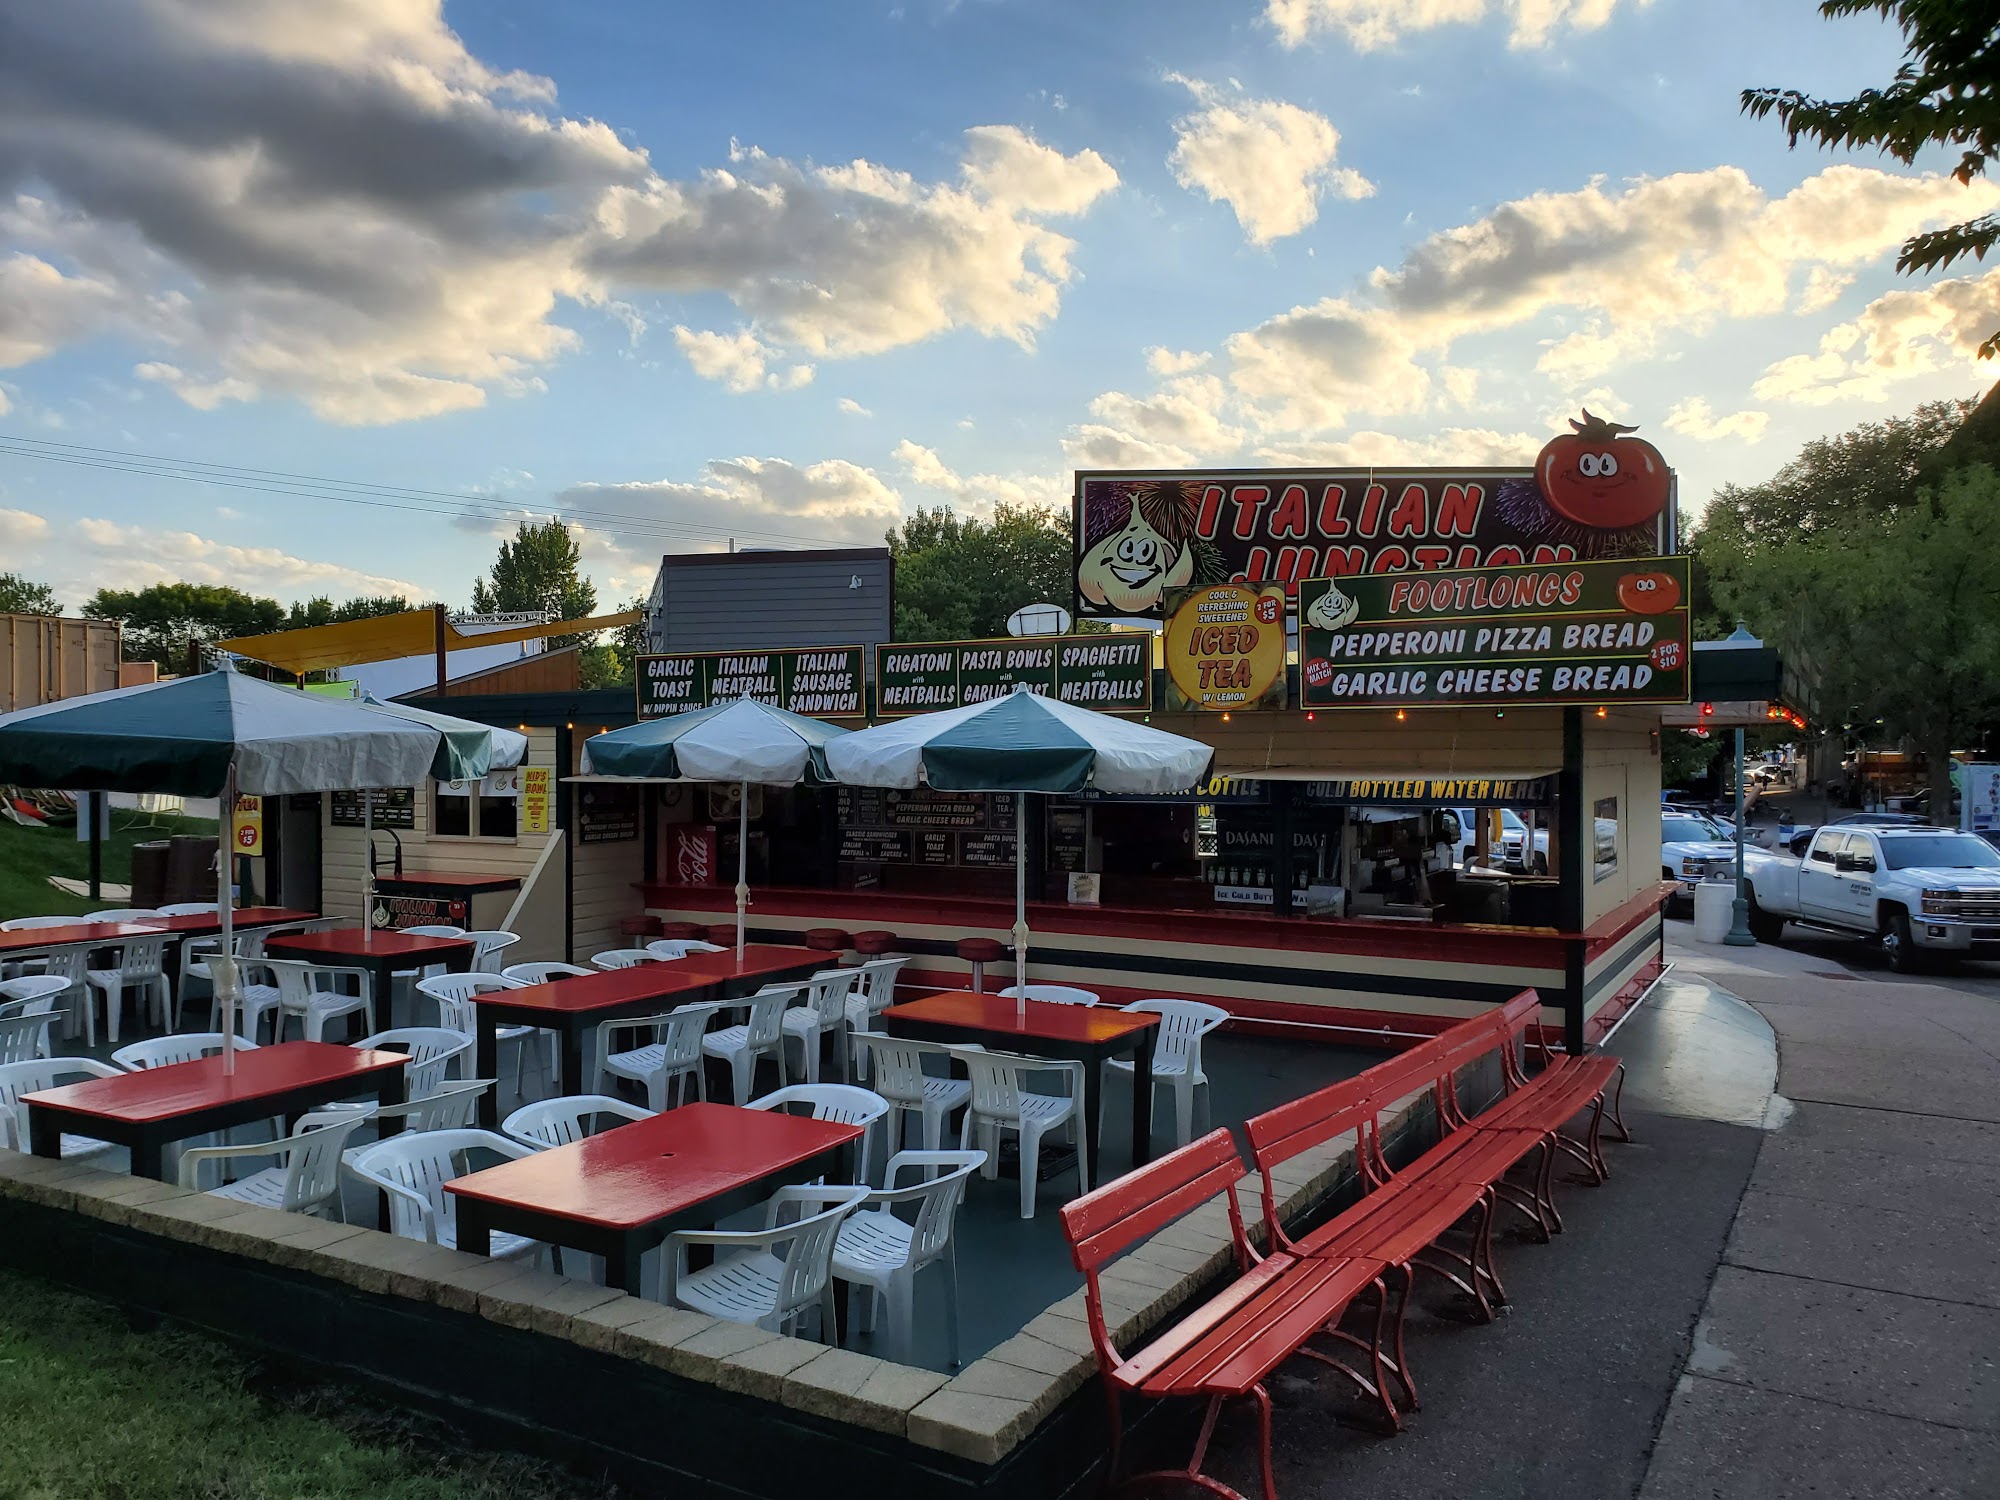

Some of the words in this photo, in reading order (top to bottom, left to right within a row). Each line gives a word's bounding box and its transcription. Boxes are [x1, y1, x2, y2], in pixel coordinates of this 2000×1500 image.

[1195, 483, 1485, 540] ITALIAN
[1209, 591, 1228, 600] COOL
[1231, 590, 1238, 599] &
[1389, 571, 1584, 614] FOOTLONGS
[1198, 601, 1249, 612] REFRESHING
[1263, 600, 1276, 609] FOR
[1199, 613, 1248, 623] SWEETENED
[1263, 608, 1276, 620] $5
[1189, 625, 1259, 656] ICED
[1330, 629, 1466, 658] PEPPERONI
[1475, 626, 1552, 652] PIZZA
[1563, 622, 1654, 649] BREAD
[1061, 645, 1142, 667] SPAGHETTI
[1651, 648, 1657, 659] 2
[1660, 643, 1680, 656] FOR
[717, 656, 769, 675] ITALIAN
[796, 652, 848, 672] ITALIAN
[886, 653, 952, 674] RIGATONI
[961, 651, 1002, 671] PASTA
[1006, 649, 1053, 669] BOWLS
[1660, 655, 1677, 669] $10
[647, 659, 694, 677] GARLIC
[1092, 670, 1105, 679] with
[1198, 659, 1252, 689] TEA
[1307, 662, 1320, 674] MIX
[1309, 668, 1332, 683] MATCH
[792, 673, 853, 691] SAUSAGE
[912, 676, 925, 684] with
[1000, 673, 1012, 681] with
[1332, 670, 1427, 696] GARLIC
[1436, 668, 1542, 694] CHEESE
[1552, 665, 1653, 691] BREAD
[652, 680, 693, 698] TOAST
[711, 676, 776, 695] MEATBALL
[964, 684, 1007, 702] GARLIC
[1060, 679, 1143, 701] MEATBALLS
[788, 692, 857, 712] SANDWICH
[883, 685, 956, 704] MEATBALLS
[1203, 693, 1215, 702] W/
[1217, 692, 1246, 701] LEMON
[643, 704, 653, 713] W/
[654, 703, 678, 713] DIPPIN
[679, 703, 703, 712] SAUCE
[526, 771, 547, 782] KID'S
[525, 783, 547, 794] BOWL
[1306, 780, 1345, 798] COLD
[1350, 780, 1425, 799] BOTTLED
[1430, 780, 1490, 799] WATER
[238, 798, 258, 811] TEA
[995, 794, 1011, 803] ICED
[896, 803, 931, 812] PEPPERONI
[932, 804, 951, 812] PIZZA
[953, 804, 976, 813] BREAD
[997, 805, 1009, 813] TEA
[896, 815, 921, 824] GARLIC
[923, 816, 949, 824] CHEESE
[951, 817, 975, 825] BREAD
[243, 836, 253, 844] $5
[1001, 834, 1017, 842] BOWL
[1225, 831, 1274, 845] DASANI
[1293, 833, 1318, 847] DAS
[1254, 892, 1272, 901] BOTT
[1292, 895, 1307, 903] WAT
[389, 899, 437, 915] ITALIAN
[394, 913, 452, 927] JUNCTION
